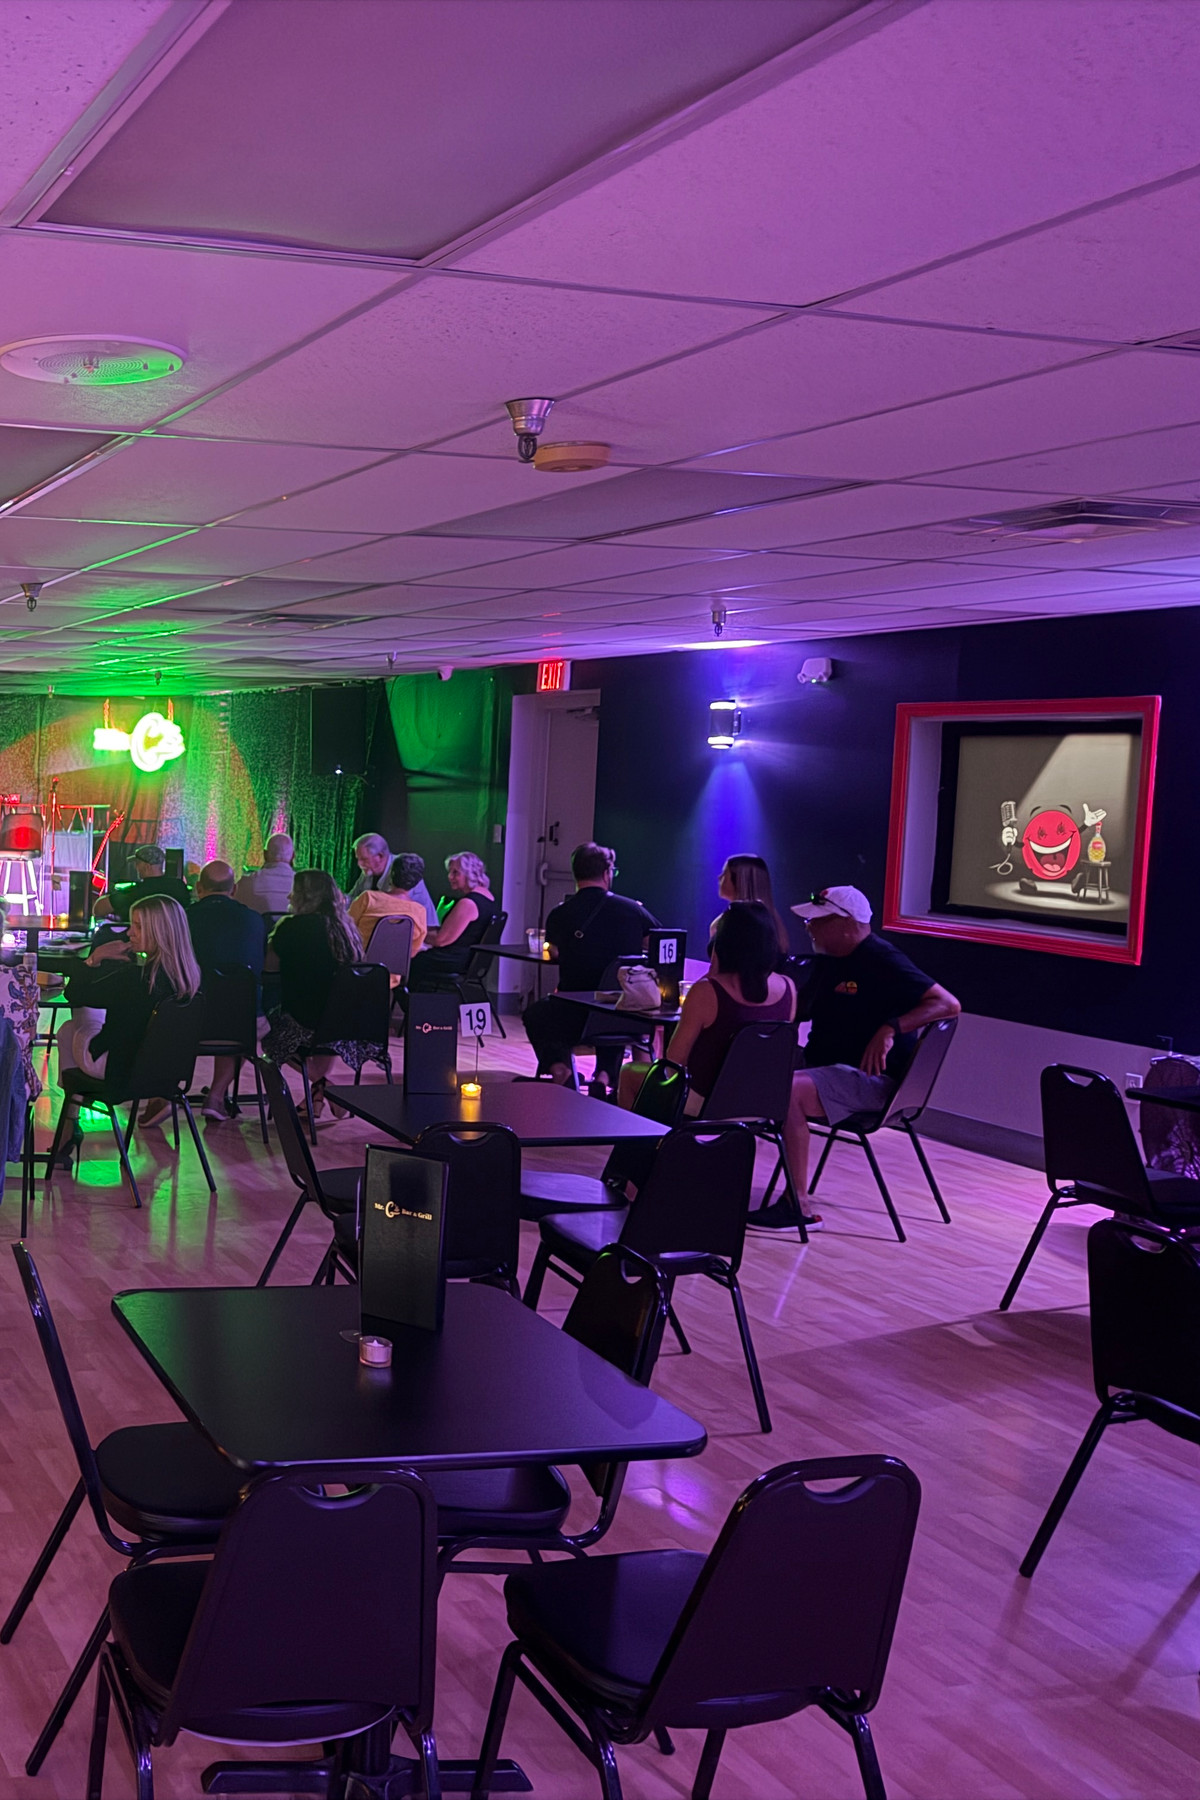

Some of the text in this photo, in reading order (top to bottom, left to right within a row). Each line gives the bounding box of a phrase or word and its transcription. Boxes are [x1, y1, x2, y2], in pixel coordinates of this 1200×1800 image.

[541, 662, 563, 689] EXIT
[662, 943, 673, 960] 16
[466, 1008, 486, 1031] 19
[417, 1212, 433, 1220] Grill
